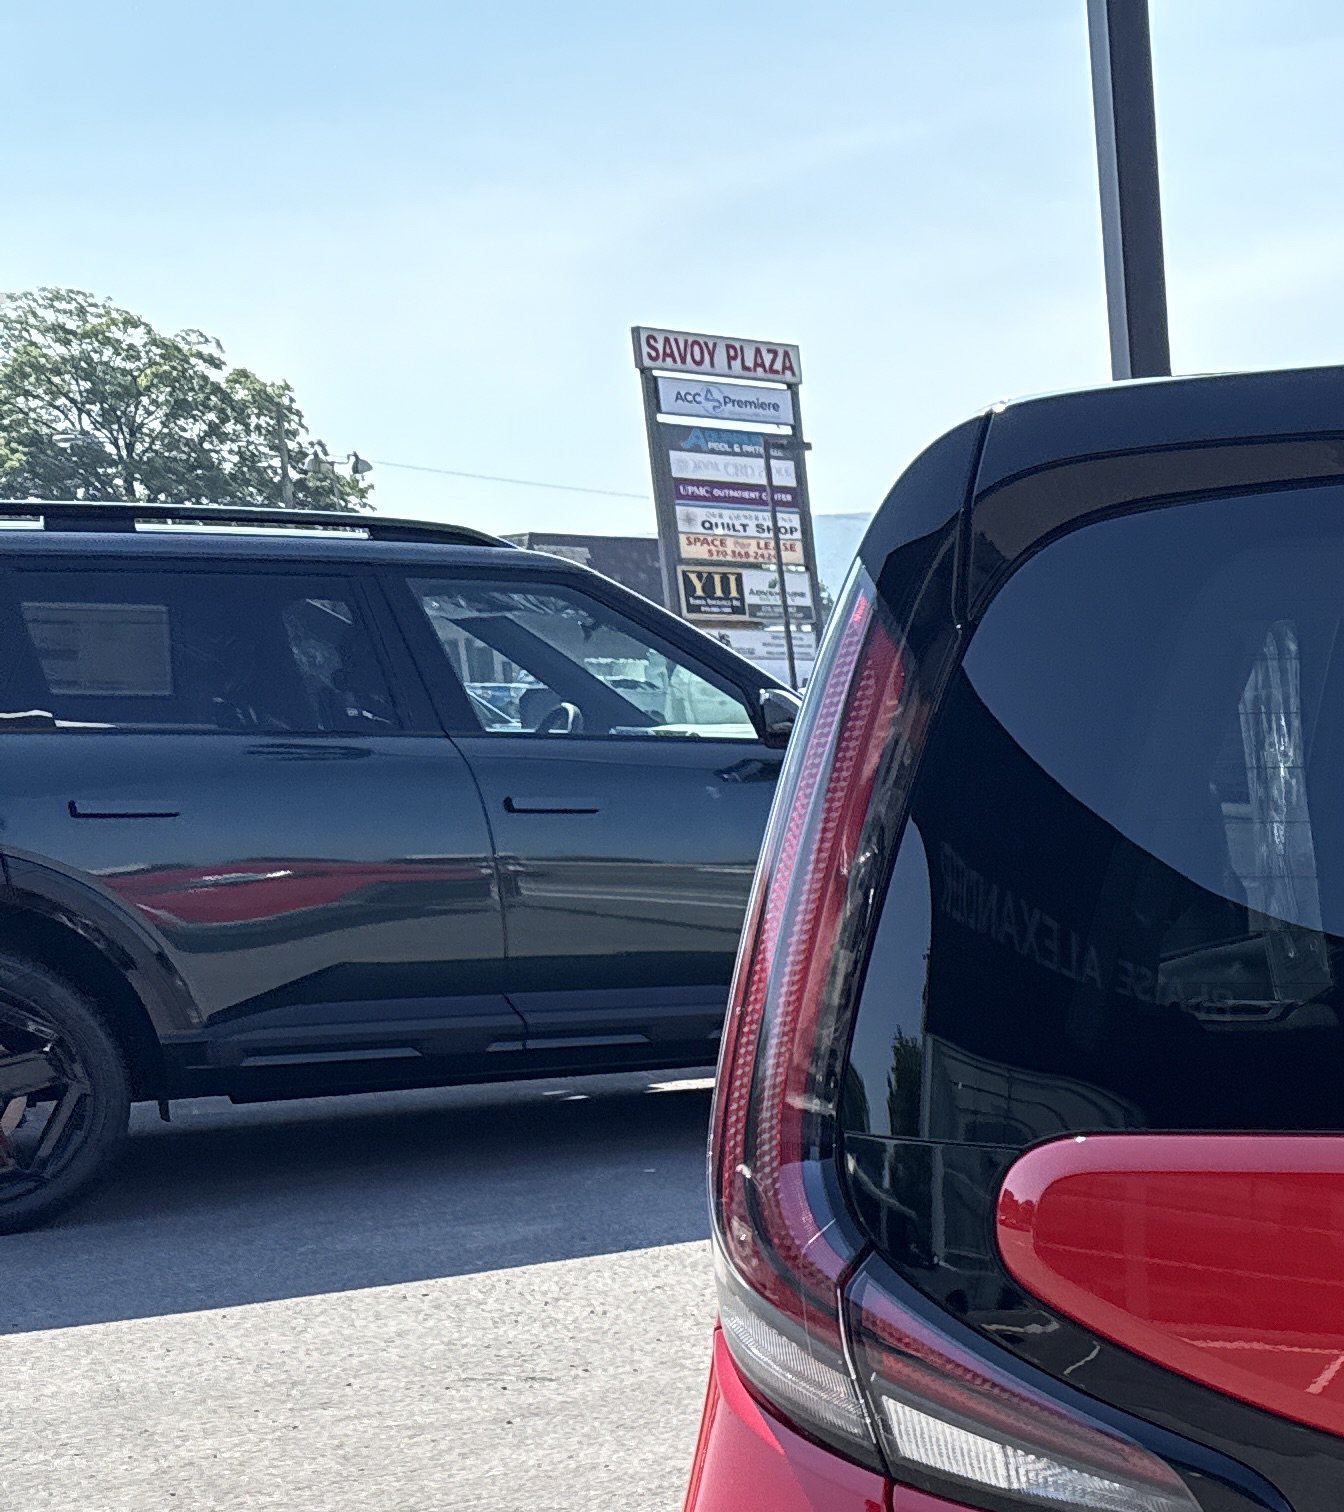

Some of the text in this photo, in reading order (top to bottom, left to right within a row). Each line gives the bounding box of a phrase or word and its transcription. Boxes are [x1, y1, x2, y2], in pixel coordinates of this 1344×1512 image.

[645, 334, 796, 377] SAVOY PLAZA
[674, 390, 780, 412] ACC Premiere
[679, 485, 711, 497] UPMC
[701, 520, 749, 533] QUILT
[686, 536, 728, 547] SPACE
[756, 541, 797, 552] LESE
